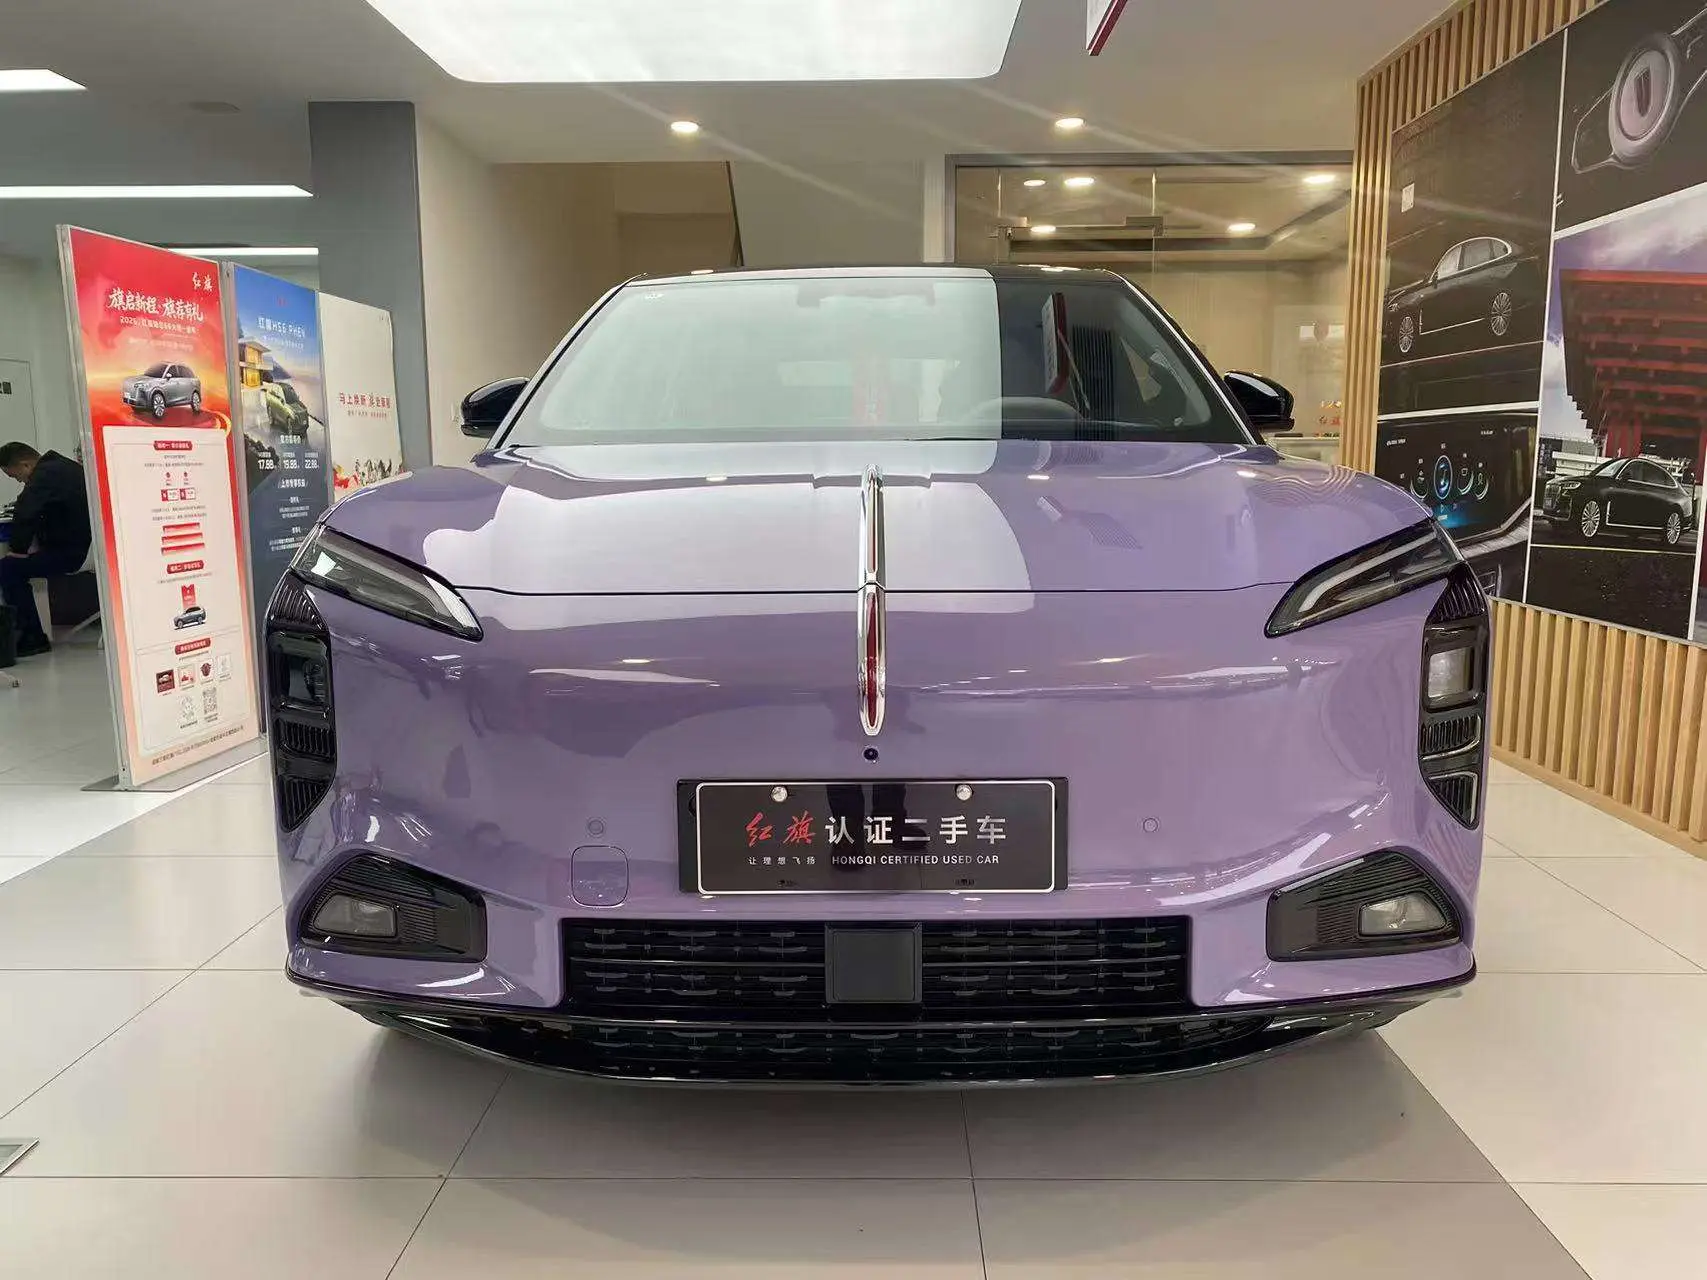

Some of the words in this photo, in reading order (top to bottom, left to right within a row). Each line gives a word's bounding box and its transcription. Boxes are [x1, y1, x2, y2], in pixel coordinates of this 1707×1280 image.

[192, 271, 213, 291] 红旗
[748, 856, 816, 865] 让理想飞扬
[832, 855, 876, 865] HONGQI
[880, 855, 939, 865] CERTIFIED
[943, 855, 972, 865] USED
[976, 855, 999, 865] CAR
